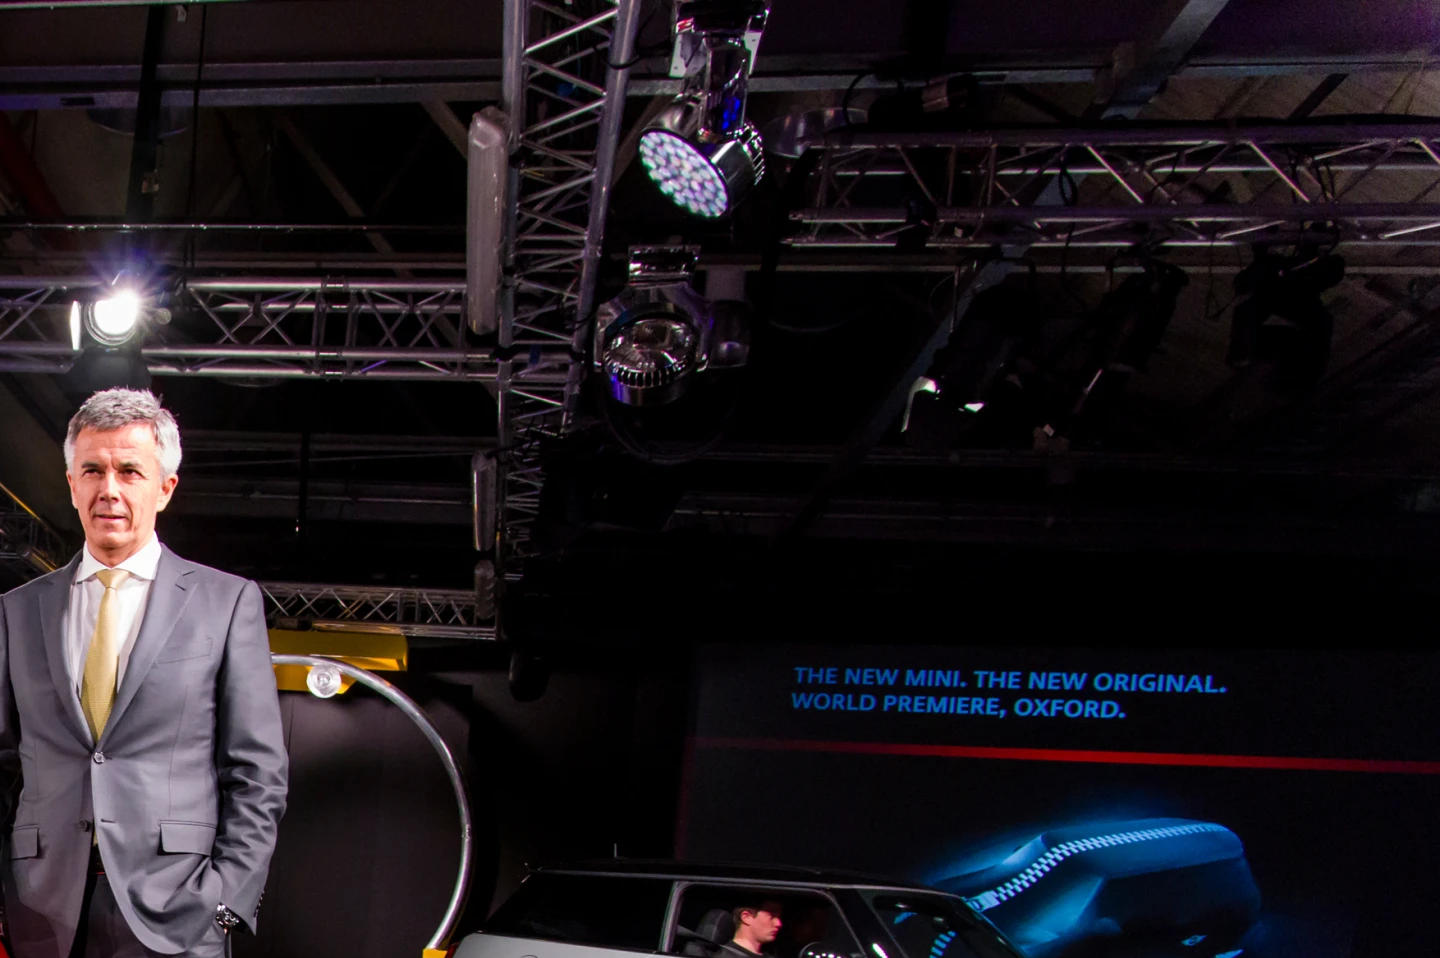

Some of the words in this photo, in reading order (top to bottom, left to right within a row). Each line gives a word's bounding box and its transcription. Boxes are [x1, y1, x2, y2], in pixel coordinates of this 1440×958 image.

[794, 666, 838, 685] THE
[844, 667, 900, 687] NEW
[904, 668, 968, 689] MINI.
[973, 670, 1023, 690] THE
[1027, 670, 1089, 692] NEW
[1093, 672, 1228, 694] ORIGINAL.
[791, 692, 877, 712] WORLD
[883, 694, 1008, 720] PREMIERE,
[1014, 697, 1127, 720] OXFORD.
